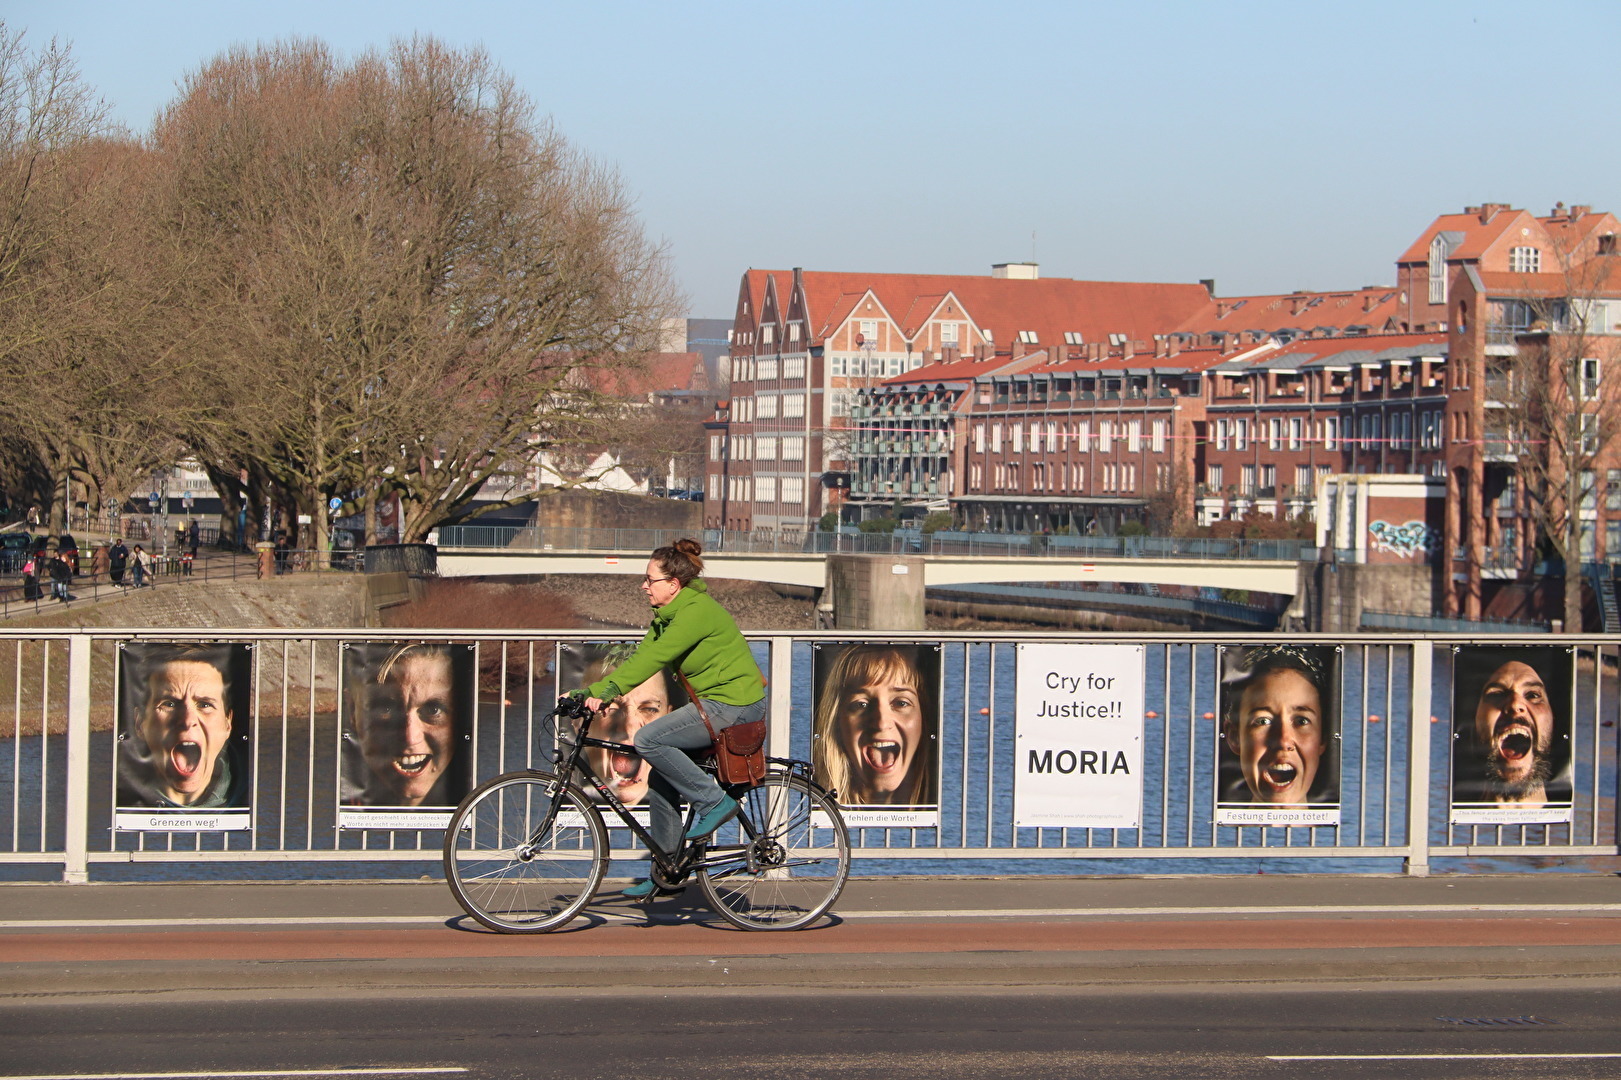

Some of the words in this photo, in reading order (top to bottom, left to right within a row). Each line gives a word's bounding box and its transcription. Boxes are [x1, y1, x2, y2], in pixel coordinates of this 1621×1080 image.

[1046, 672, 1081, 694] Cry
[1087, 672, 1115, 690] for
[1036, 700, 1122, 718] Justice!!
[1028, 749, 1131, 775] MORIA
[149, 817, 192, 827] Grenzen
[194, 817, 219, 828] weg!
[1226, 812, 1264, 821] Festung
[1266, 812, 1300, 821] Europa
[1302, 812, 1329, 821] tötet!
